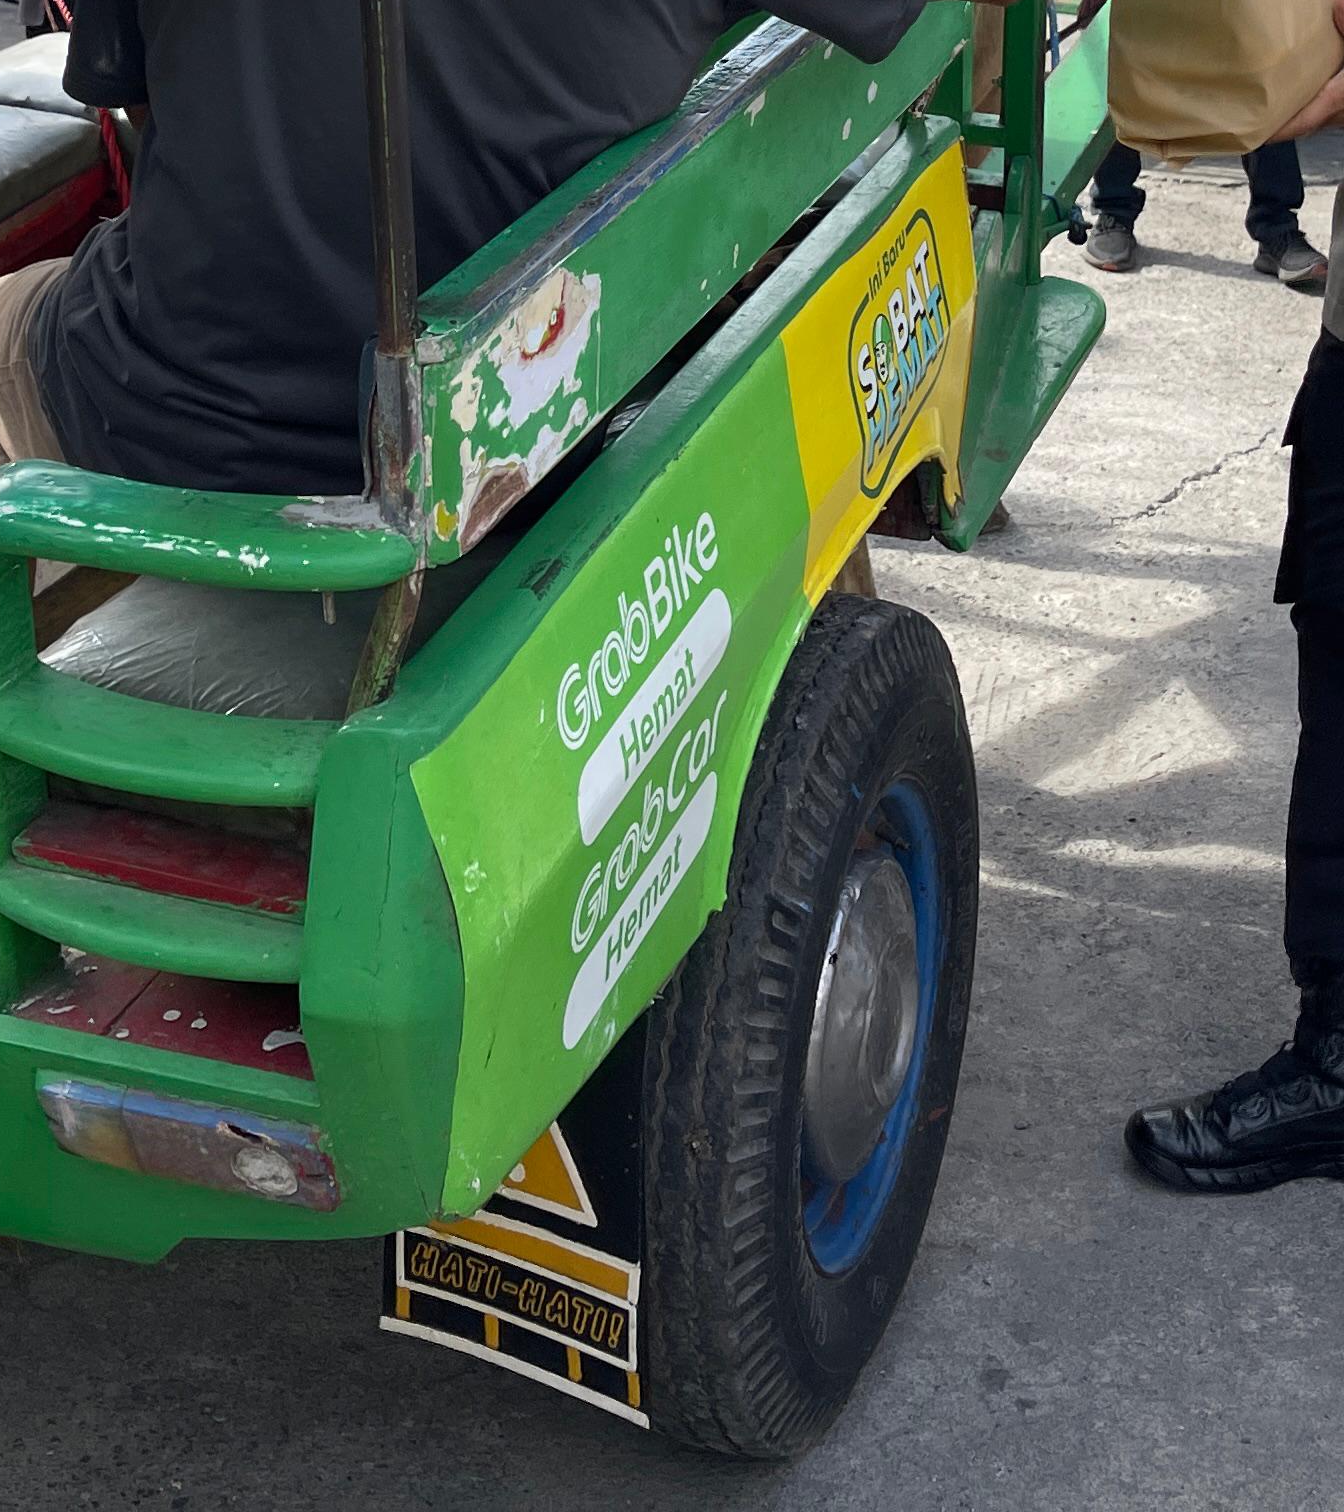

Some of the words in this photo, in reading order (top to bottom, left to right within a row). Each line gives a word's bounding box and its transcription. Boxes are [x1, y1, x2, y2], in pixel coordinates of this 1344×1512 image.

[868, 272, 883, 302] Ini
[883, 228, 906, 279] Baru
[866, 283, 944, 475] HEMAT
[557, 511, 719, 751] GrabBike
[618, 647, 697, 782] Hemat
[571, 689, 728, 954] GrabCar
[604, 833, 683, 984] Hemat
[410, 1241, 625, 1349] HATI-HATI!
